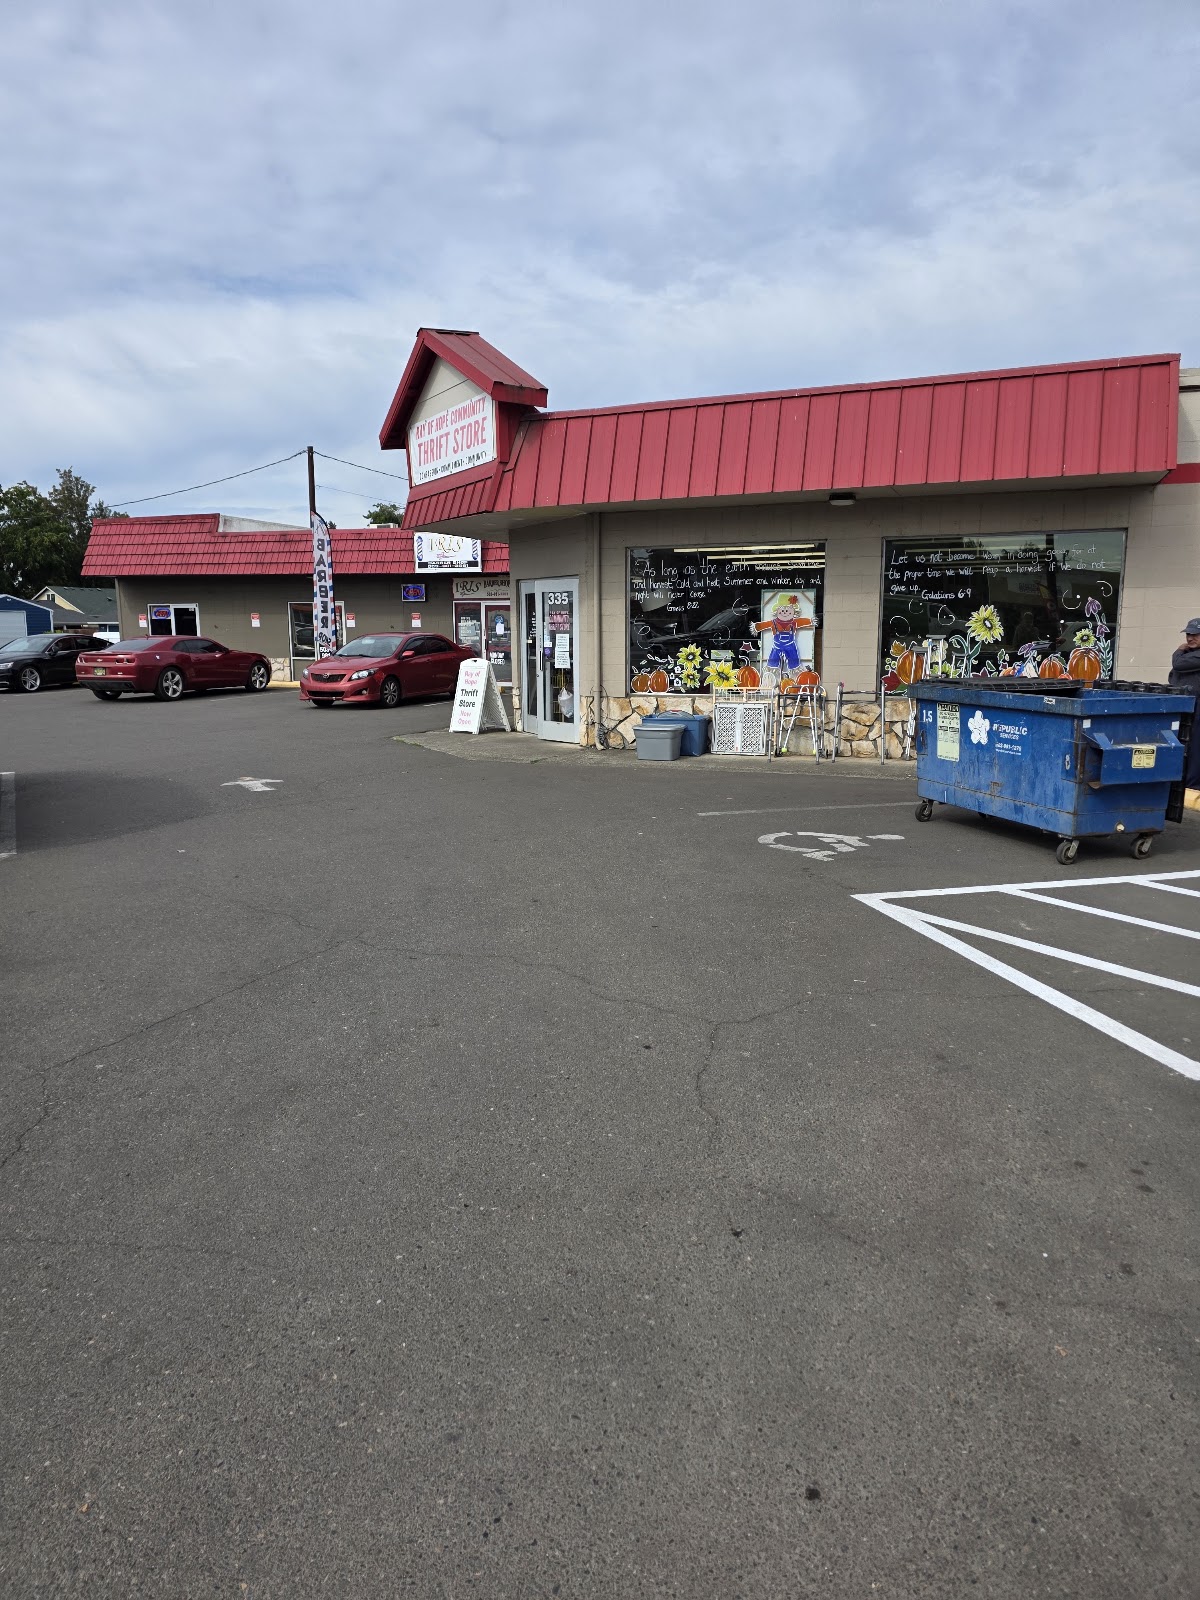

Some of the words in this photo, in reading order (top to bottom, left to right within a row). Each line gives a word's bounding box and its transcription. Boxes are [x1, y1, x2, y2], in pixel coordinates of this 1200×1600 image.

[415, 421, 427, 440] RAY
[427, 420, 435, 436] OF
[435, 411, 449, 432] HOPE
[450, 396, 487, 426] COMMUNITY
[417, 432, 450, 467] THRIFT
[452, 416, 488, 455] STORE
[890, 550, 908, 565] Let
[915, 554, 926, 563] us
[930, 549, 943, 563] not
[946, 548, 976, 562] become
[1007, 552, 1015, 561] in
[1017, 550, 1039, 565] doing
[1071, 544, 1084, 557] for
[1087, 544, 1097, 554] at
[661, 559, 678, 582] long
[684, 565, 696, 575] as
[700, 557, 718, 575] the
[725, 557, 750, 573] earth
[888, 567, 901, 580] the
[927, 567, 942, 578] time
[959, 566, 974, 576] will
[1016, 562, 1042, 573] harvest
[1076, 559, 1087, 570] do
[1091, 558, 1106, 570] not
[455, 580, 482, 593] IRIS
[693, 578, 704, 588] and
[756, 577, 768, 585] and
[667, 591, 685, 599] never
[889, 583, 906, 596] give
[957, 588, 972, 599] 6:9
[548, 592, 569, 605] 335
[464, 670, 474, 678] Ray
[460, 689, 479, 697] Thrift
[459, 699, 476, 708] Store
[992, 723, 1028, 736] REPUBLIC
